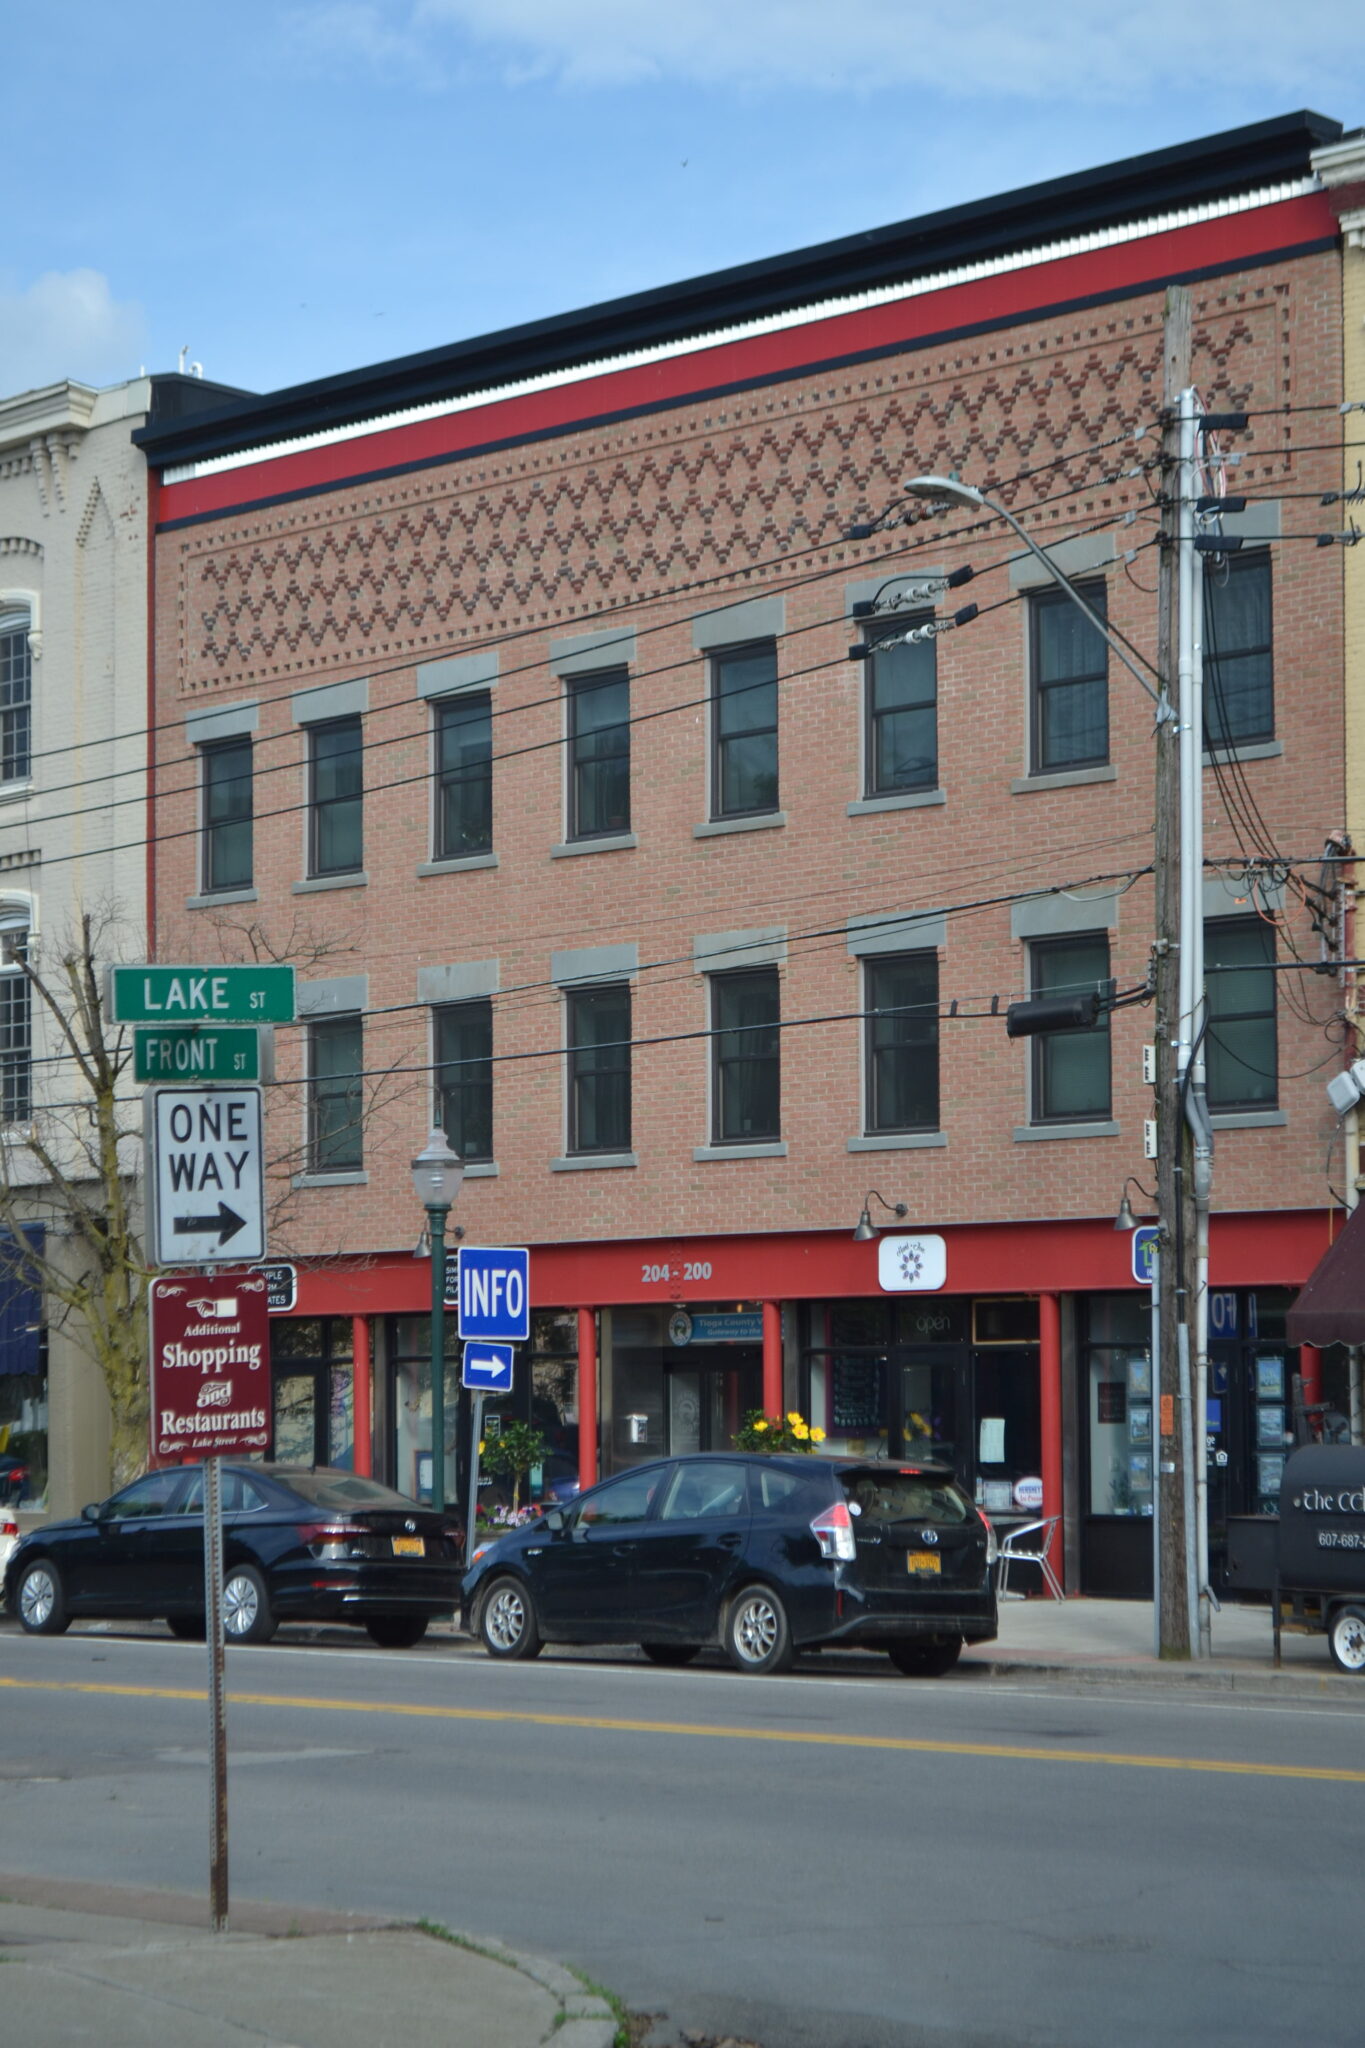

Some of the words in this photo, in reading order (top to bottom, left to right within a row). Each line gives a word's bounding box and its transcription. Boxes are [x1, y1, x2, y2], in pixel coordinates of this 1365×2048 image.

[144, 977, 229, 1010] LAKE
[250, 992, 265, 1008] ST
[146, 1038, 218, 1071] FRONT
[234, 1053, 246, 1070] ST
[170, 1102, 248, 1143] ONE
[168, 1151, 250, 1192] WAY
[641, 1264, 670, 1282] 204
[683, 1262, 712, 1280] 200
[464, 1268, 523, 1319] INFO
[184, 1322, 241, 1337] Additional
[699, 1319, 723, 1328] Tioga
[724, 1318, 755, 1327] County
[916, 1315, 951, 1335] open
[162, 1339, 262, 1374] Shopping
[196, 1380, 233, 1408] and
[160, 1407, 266, 1435] Restaurants
[192, 1438, 212, 1448] Lake
[213, 1436, 238, 1448] Street
